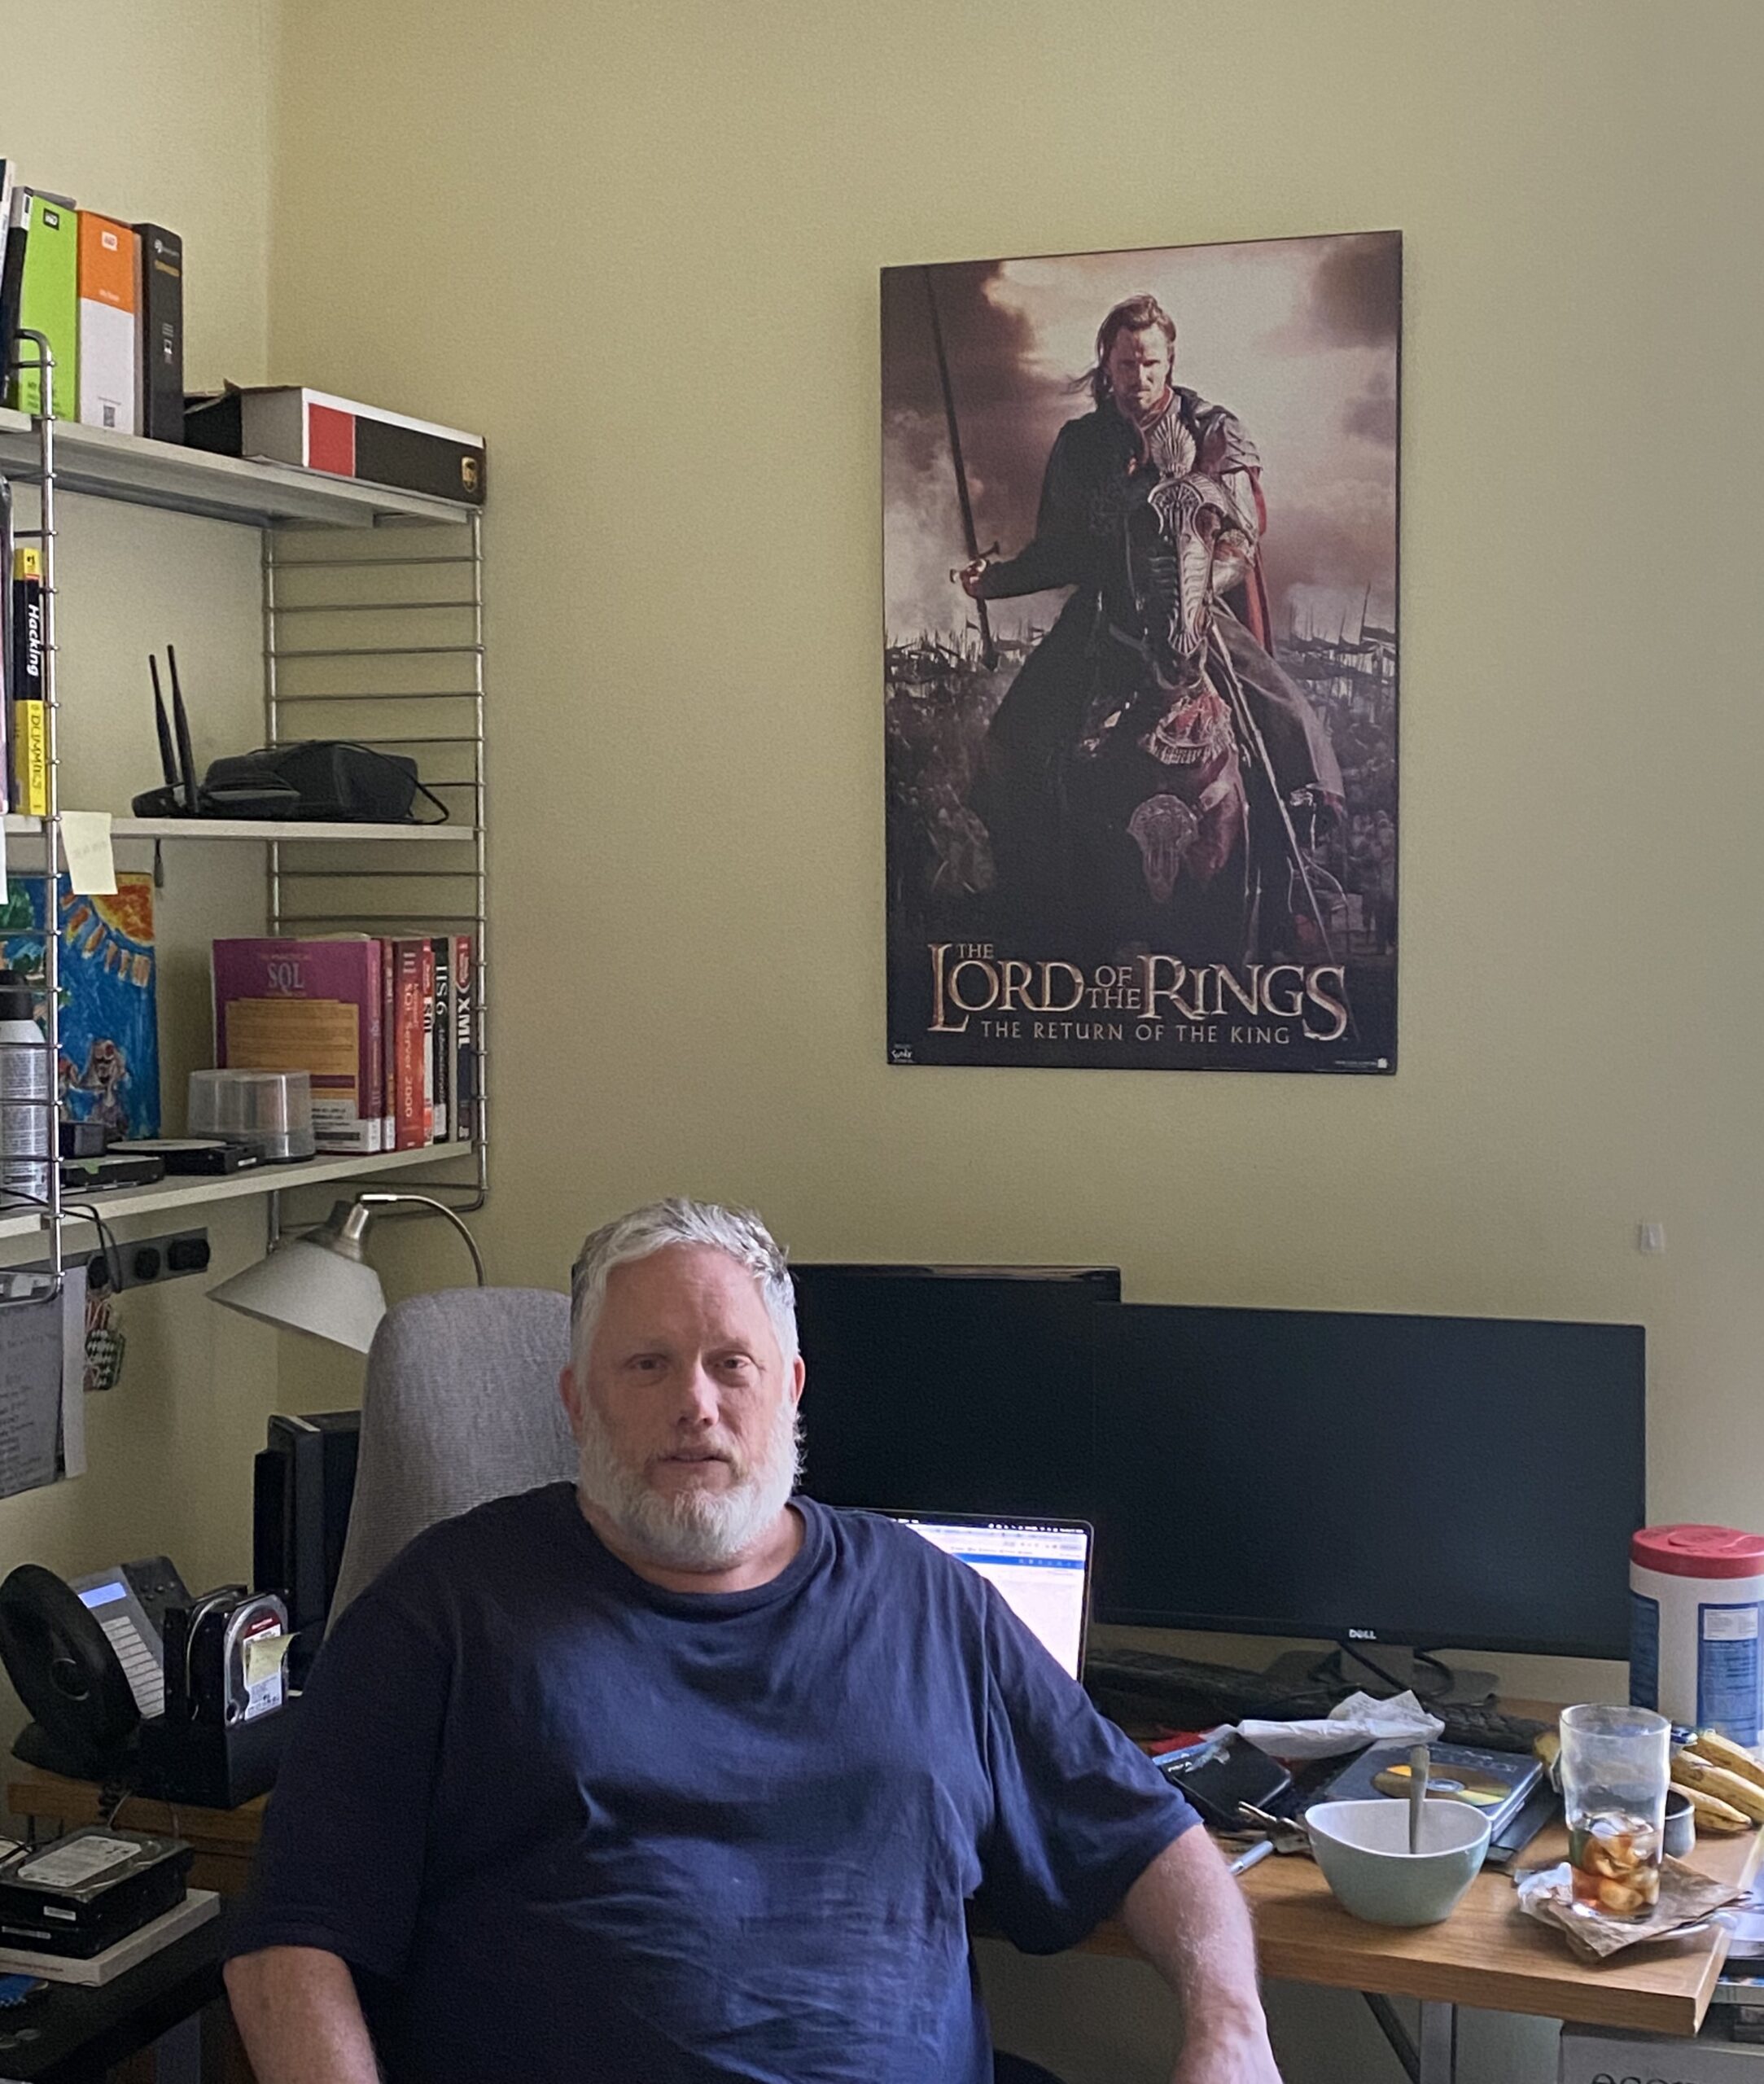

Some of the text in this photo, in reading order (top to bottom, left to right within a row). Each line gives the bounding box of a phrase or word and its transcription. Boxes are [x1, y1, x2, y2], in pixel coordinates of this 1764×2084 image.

[26, 603, 40, 676] Hacking
[267, 962, 305, 995] SQL
[436, 965, 448, 996] IIS
[927, 943, 1347, 1040] THE LORD OF THE RINGS
[436, 1000, 448, 1015] 6
[457, 996, 471, 1049] XML
[404, 1021, 413, 1070] Server
[981, 1021, 1290, 1044] THE RETURN OF THE KING
[404, 1075, 414, 1118] 2000
[1349, 1629, 1377, 1640] DELL
